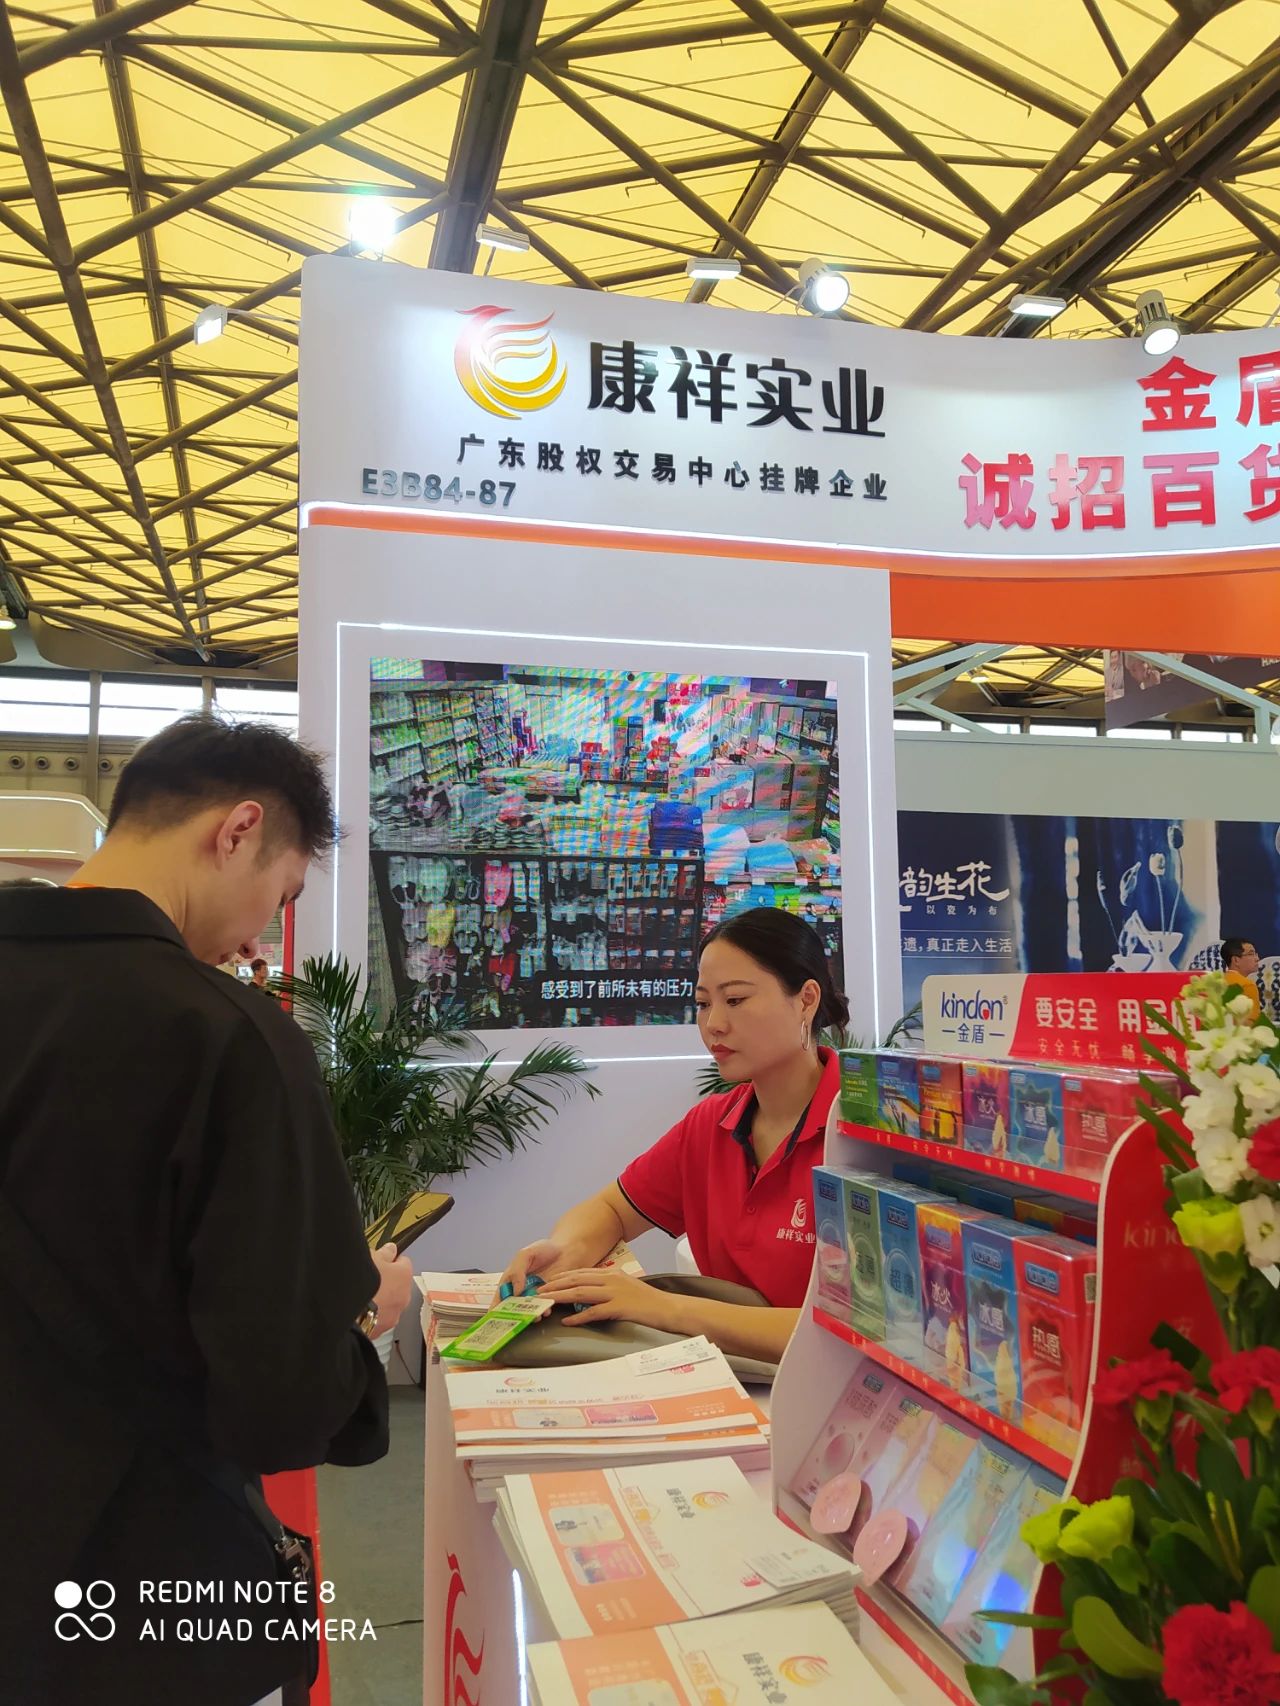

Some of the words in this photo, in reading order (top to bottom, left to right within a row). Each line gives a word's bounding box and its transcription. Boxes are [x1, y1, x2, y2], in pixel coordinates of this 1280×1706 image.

[588, 340, 887, 438] 康祥实业
[457, 433, 889, 502] 广东股权交易中心挂牌企业
[361, 467, 516, 507] E3B84-87
[958, 443, 1280, 531] 诚招百货
[901, 937, 1013, 953] 遗，真正走入生活
[541, 979, 693, 1000] 感受到了前所未有的压力
[941, 990, 1003, 1021] kindon
[1034, 997, 1099, 1032] 要安全
[957, 1023, 985, 1044] 金盾
[776, 1228, 816, 1243] 康祥实业
